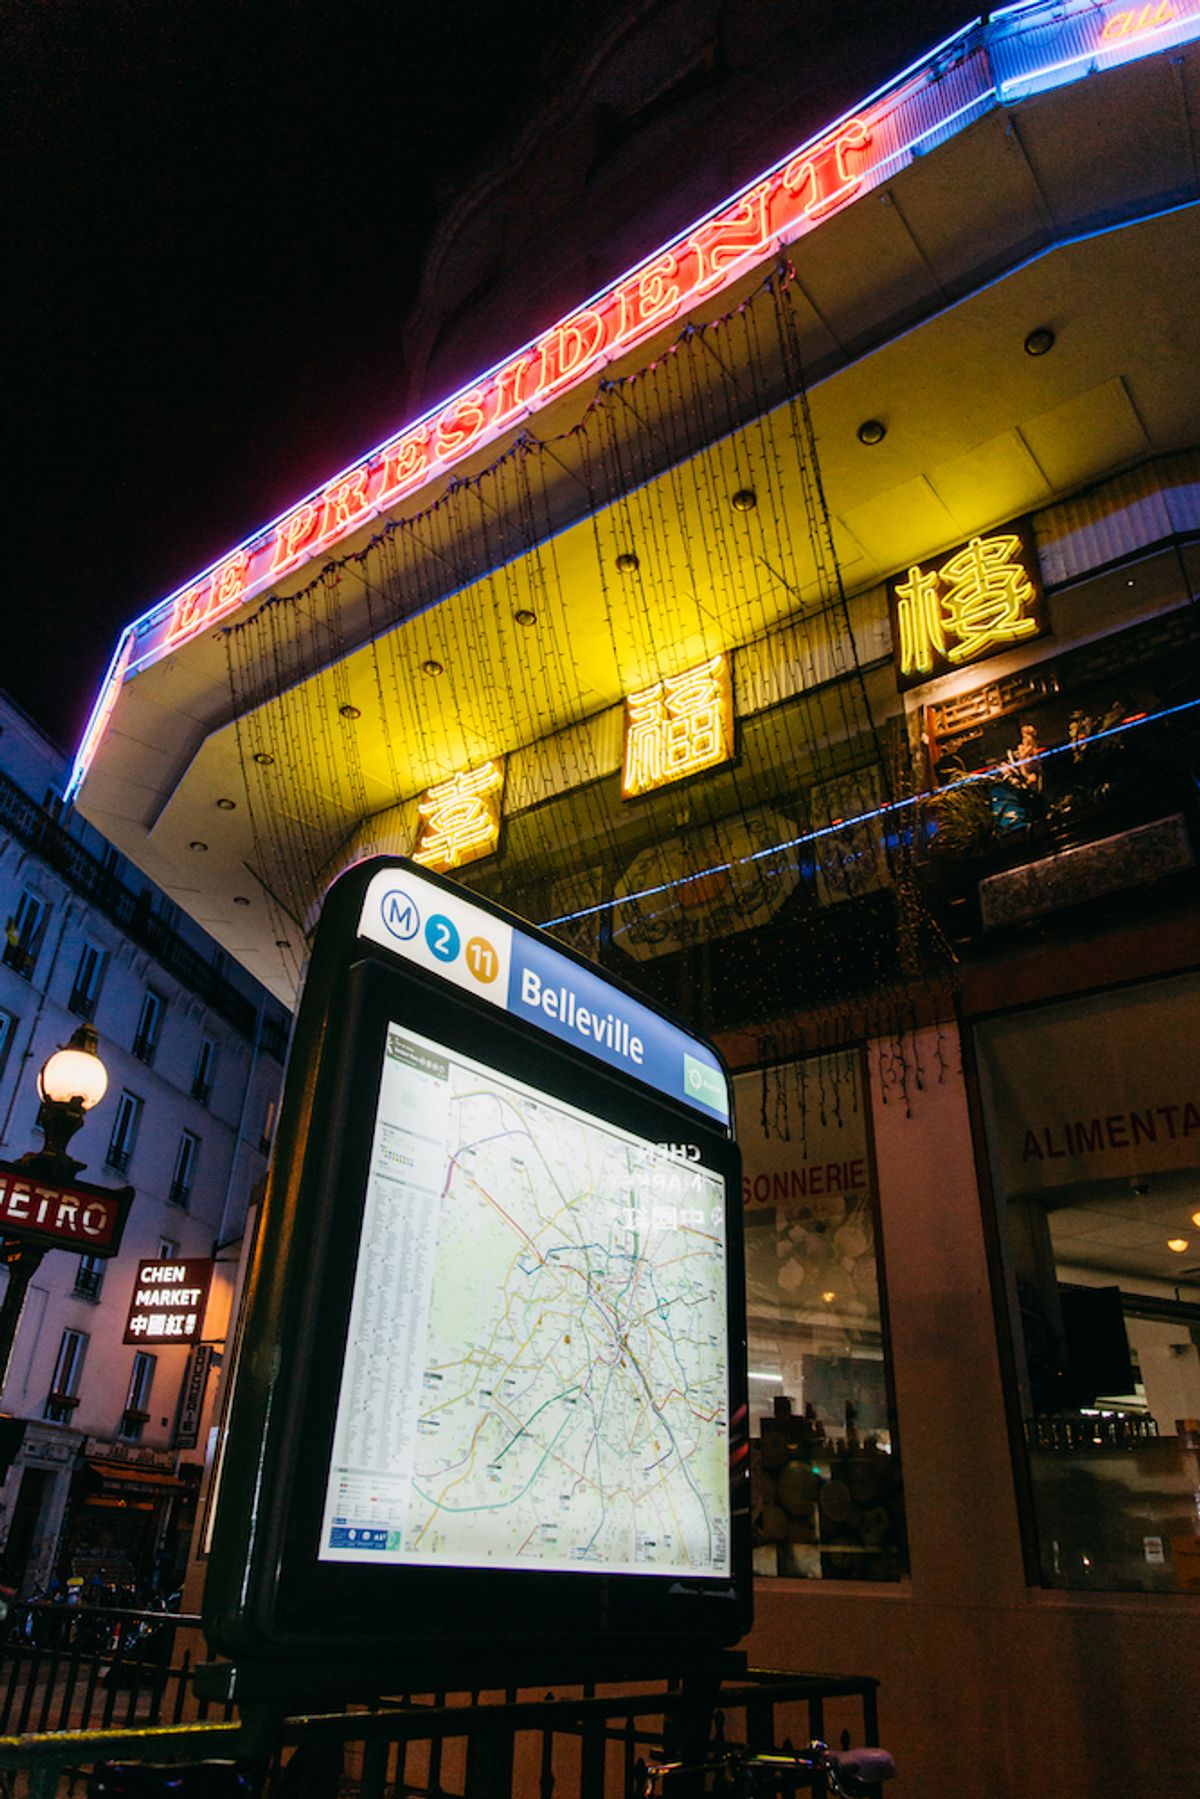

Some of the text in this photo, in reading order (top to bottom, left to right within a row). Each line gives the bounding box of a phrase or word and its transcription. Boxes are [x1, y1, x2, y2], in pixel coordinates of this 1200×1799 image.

[163, 118, 868, 644] LE PRESIDENT
[435, 922, 451, 955] 2
[470, 944, 494, 978] 11
[521, 967, 645, 1066] Belleville
[1023, 1102, 1200, 1163] ALIMENTA
[135, 1288, 202, 1307] MARKET
[140, 1265, 186, 1284] CHEN
